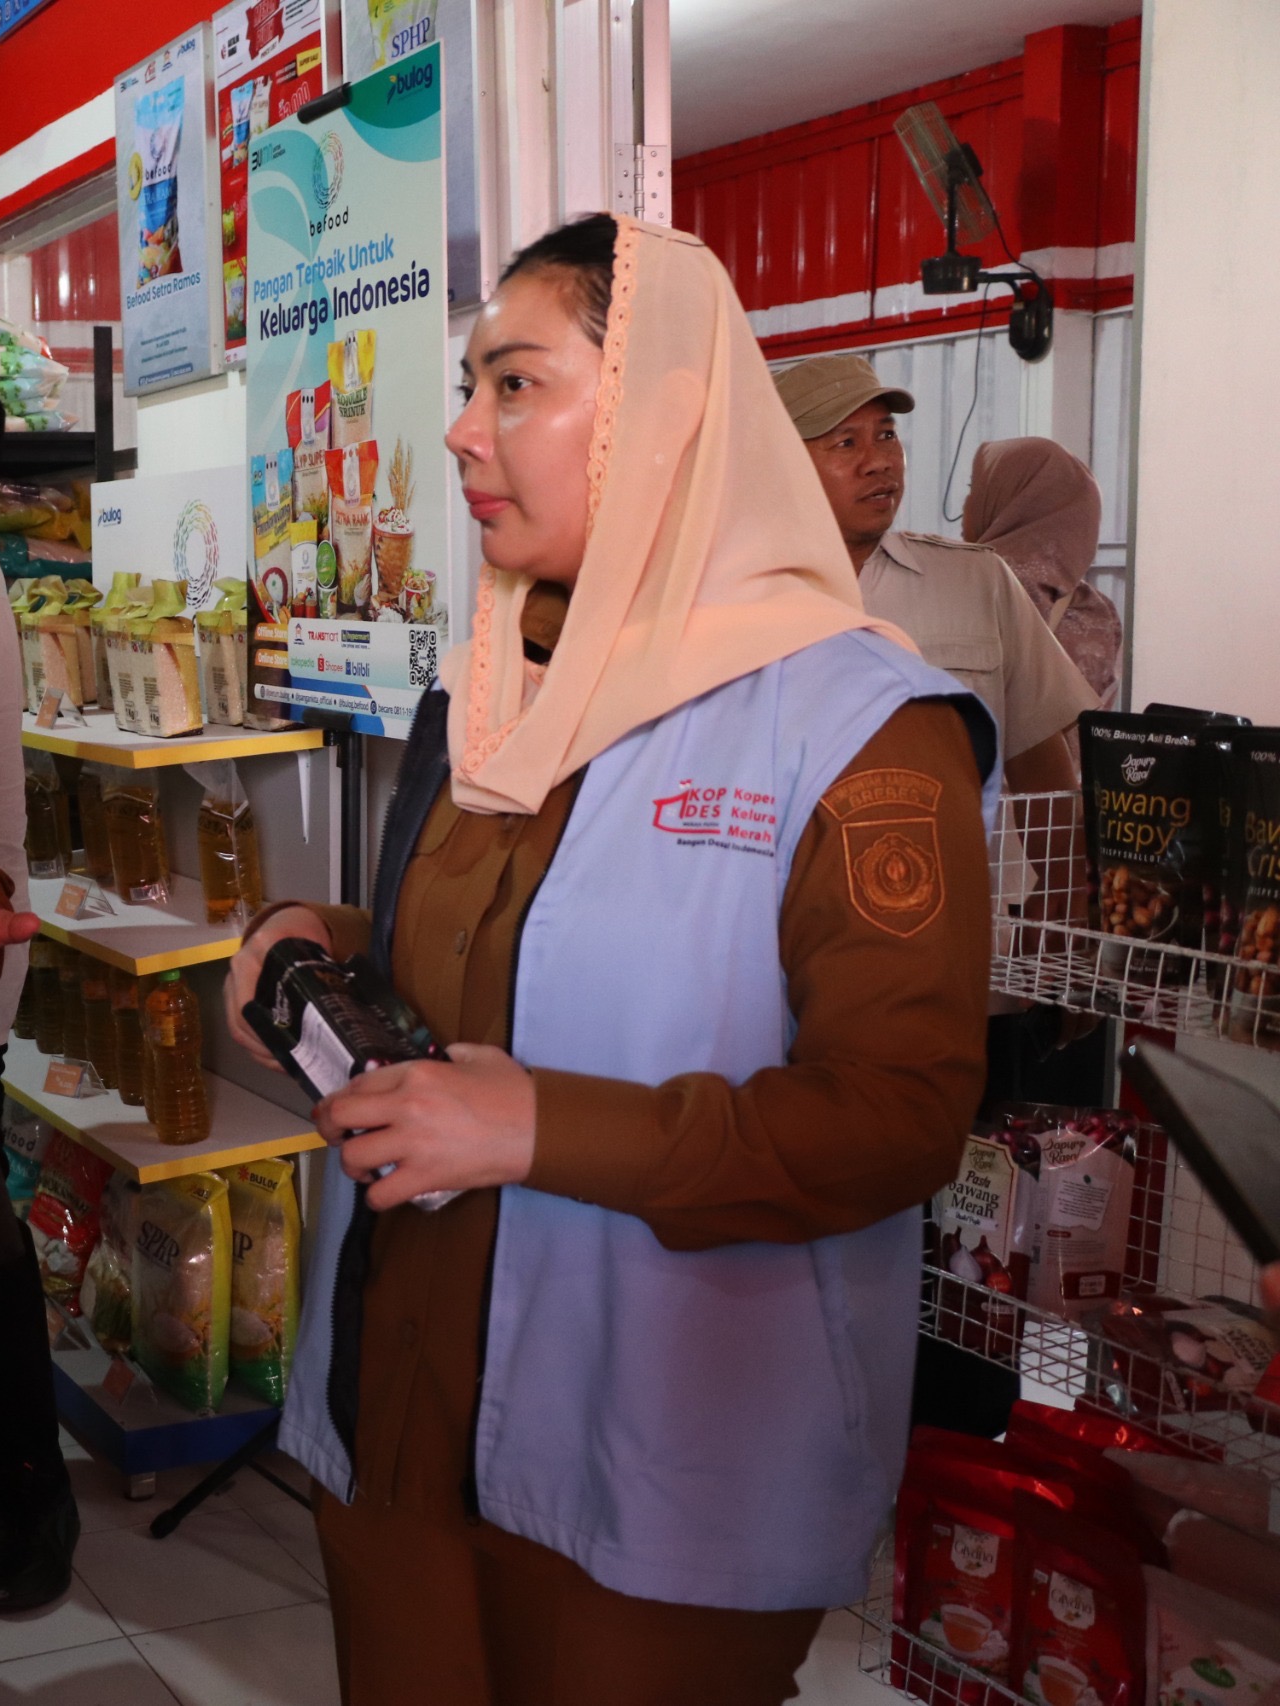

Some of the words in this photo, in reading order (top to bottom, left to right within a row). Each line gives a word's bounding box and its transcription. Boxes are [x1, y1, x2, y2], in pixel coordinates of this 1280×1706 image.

[391, 17, 431, 58] SPHP
[397, 63, 433, 94] bulog
[145, 163, 172, 181] befood
[309, 207, 349, 237] befood
[253, 272, 293, 303] Pangan
[296, 249, 346, 288] Terbaik
[349, 233, 395, 272] Untuk
[126, 288, 151, 309] Befood
[152, 281, 172, 300] Setra
[173, 272, 201, 292] Ramos
[260, 297, 329, 340] Keluarga
[333, 260, 431, 321] Indonesia
[102, 508, 122, 525] bulog
[257, 626, 274, 638] Offline
[274, 628, 288, 639] Store
[258, 652, 272, 663] Online
[272, 654, 288, 665] Store
[291, 657, 315, 669] tokopedia
[325, 661, 344, 672] Shopee
[351, 661, 370, 677] blibli
[1091, 726, 1111, 738] 100%
[1113, 730, 1146, 743] Bawang
[1147, 733, 1163, 743] Asli
[1251, 751, 1277, 763] 100%
[689, 787, 728, 802] KOP
[685, 804, 722, 818] DES
[727, 825, 773, 843] Merah
[951, 1193, 995, 1219] Merah
[137, 1220, 180, 1267] SPHP
